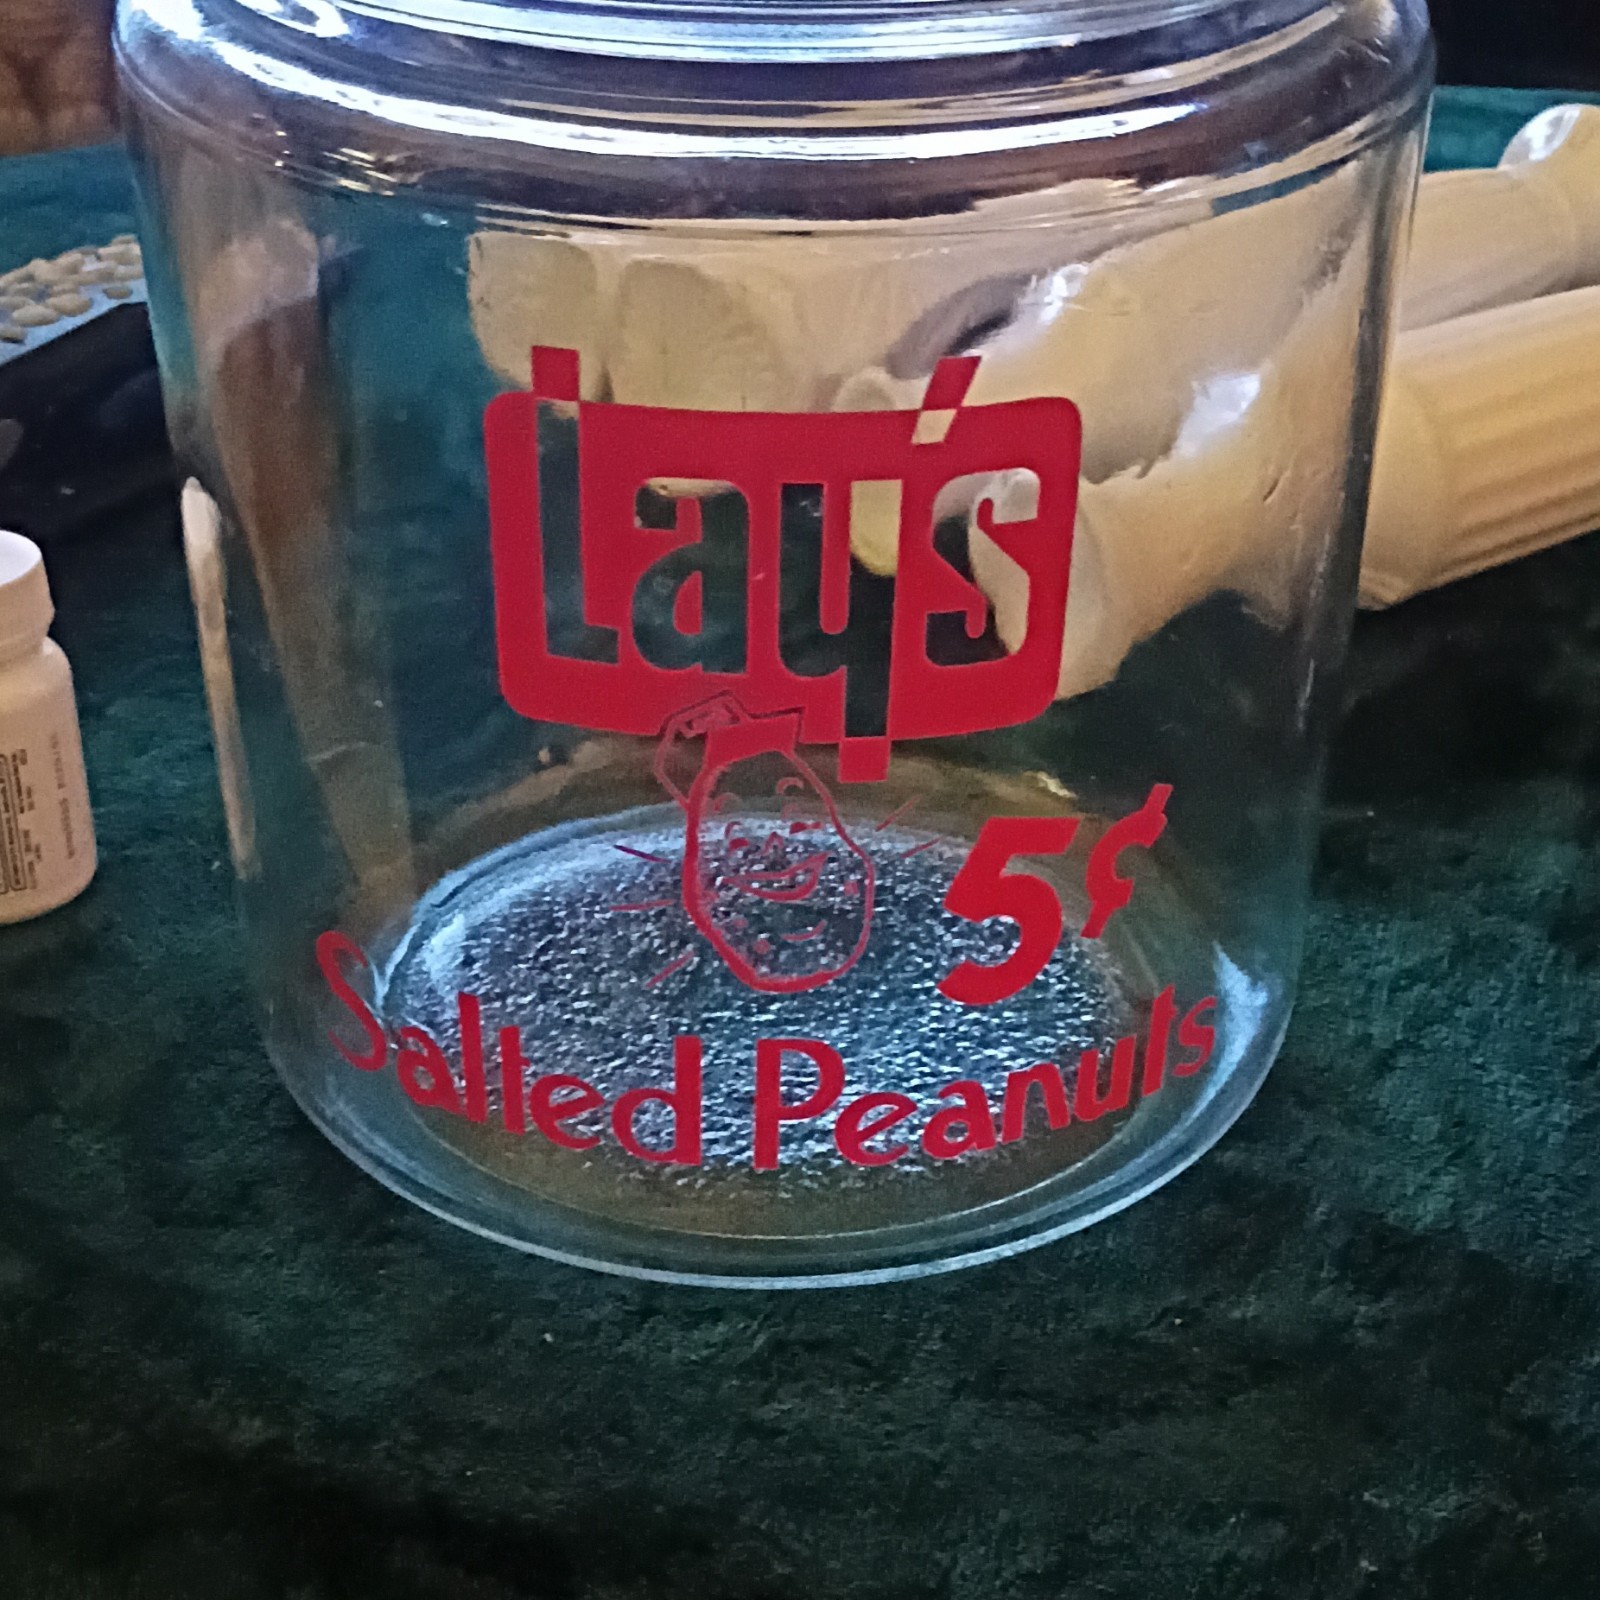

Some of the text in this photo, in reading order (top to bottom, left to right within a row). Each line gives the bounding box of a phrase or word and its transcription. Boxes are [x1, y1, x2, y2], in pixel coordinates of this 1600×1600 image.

[532, 345, 1042, 783] Lay's
[315, 930, 1217, 1171] Salted Peanuts
